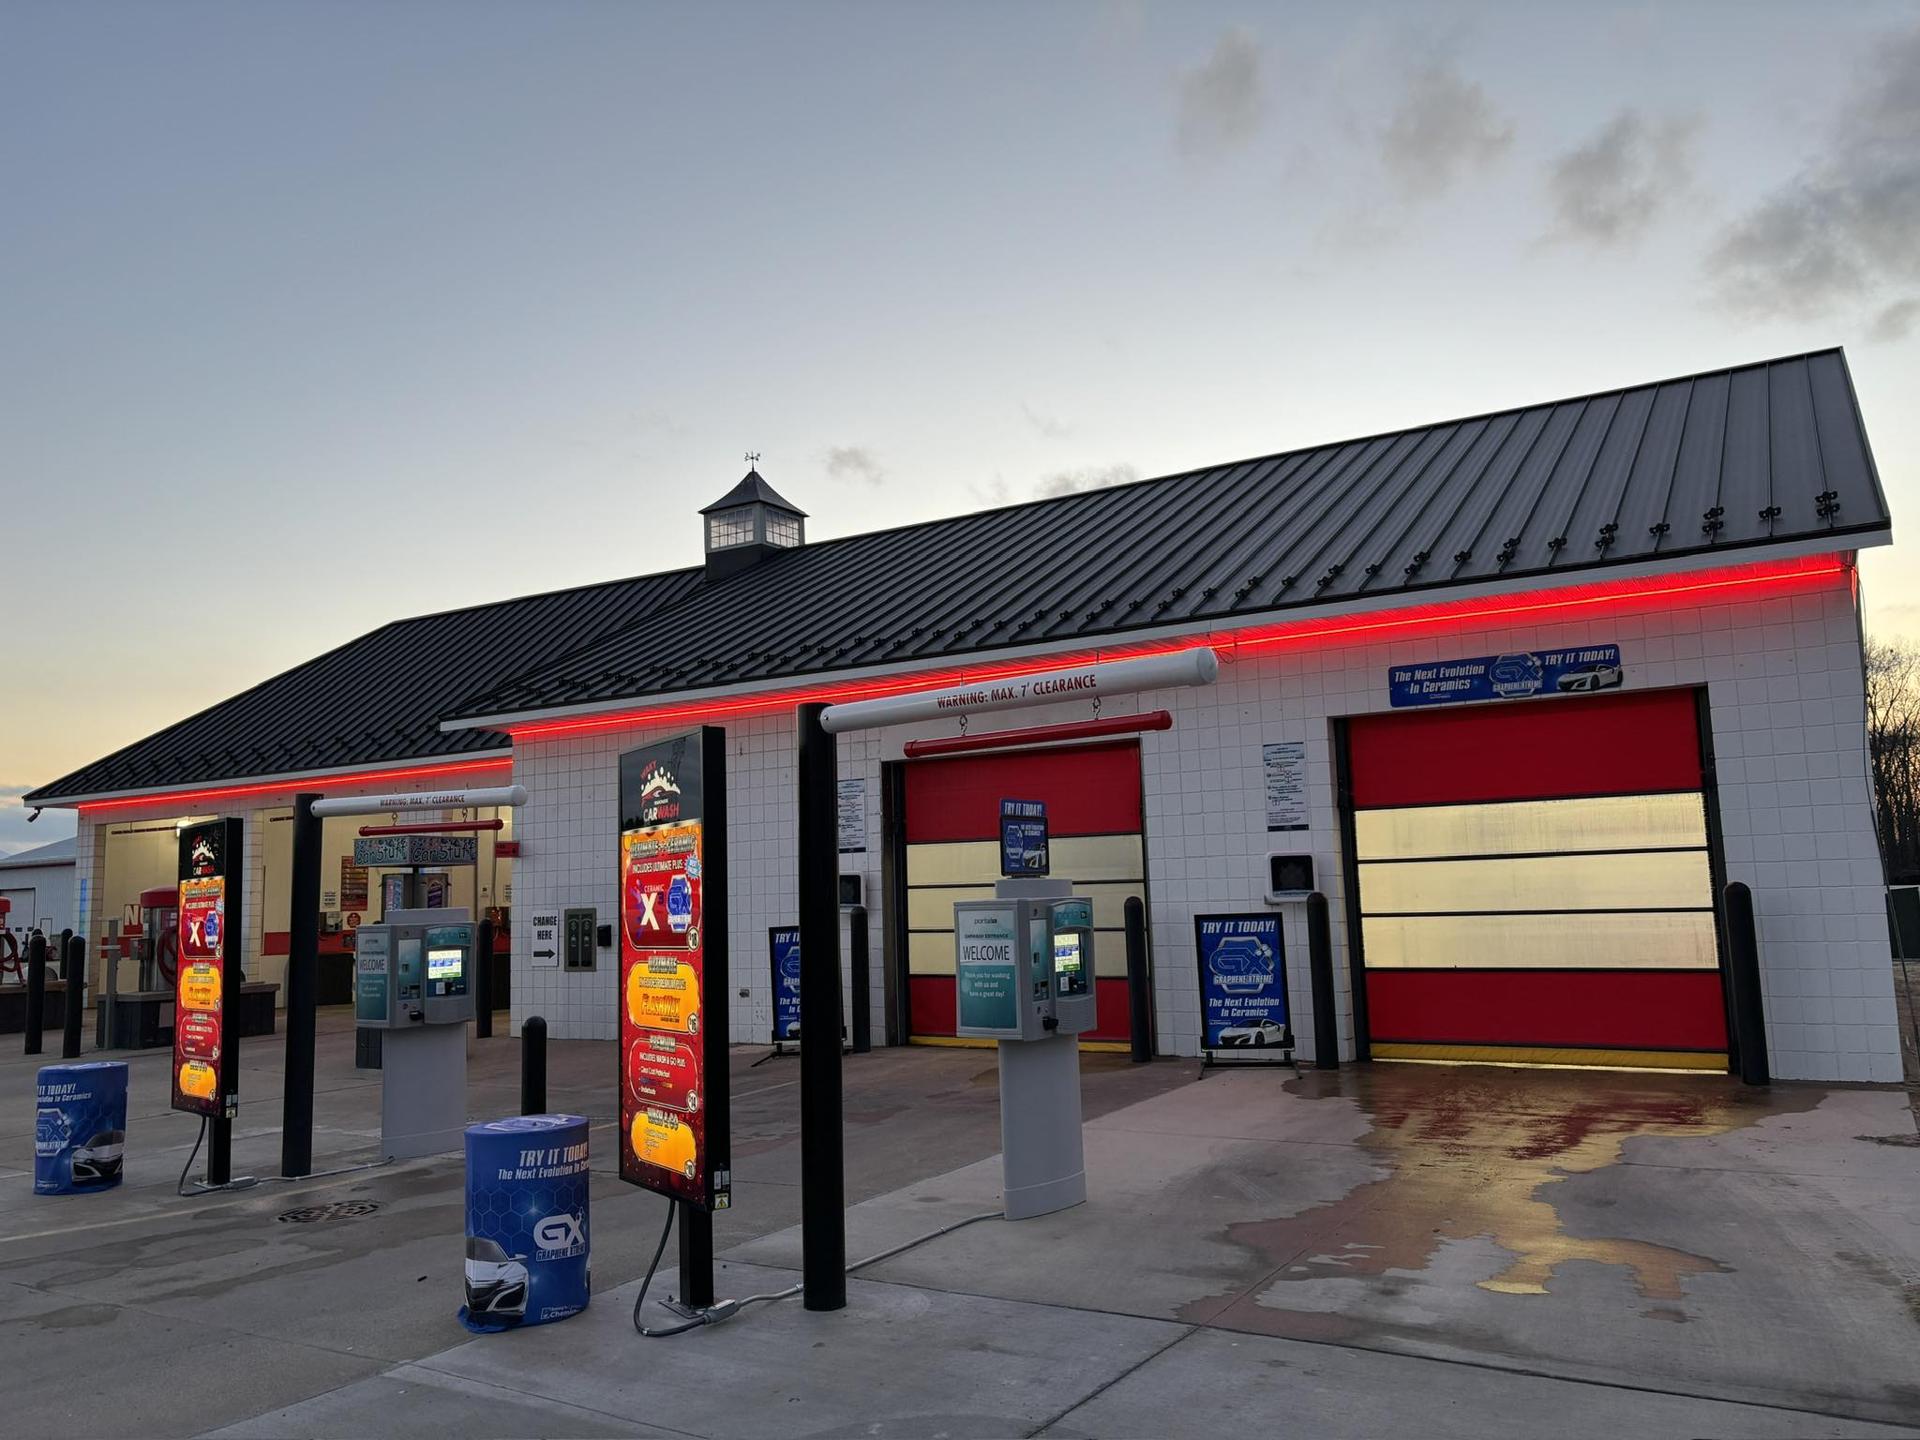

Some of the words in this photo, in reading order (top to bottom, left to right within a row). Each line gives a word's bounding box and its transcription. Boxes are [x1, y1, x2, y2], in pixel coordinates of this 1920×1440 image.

[1545, 653, 1563, 665] TRY
[1566, 652, 1577, 664] IT
[1579, 649, 1615, 662] TODAY!
[1395, 671, 1411, 682] The
[1414, 668, 1437, 680] Next
[1440, 665, 1485, 678] Evolution
[937, 691, 988, 709] WARNING:
[991, 687, 1018, 702] MAX.
[1021, 682, 1030, 697] 7'
[1033, 674, 1097, 695] CLEARANCE
[1409, 682, 1419, 694] In
[1422, 679, 1470, 693] Ceramics
[432, 794, 465, 804] CLEARANCE
[1004, 802, 1015, 815] TRY
[1015, 802, 1021, 816] IT
[1022, 803, 1043, 816] TODAY!
[438, 844, 474, 862] Stuff
[533, 916, 557, 926] CHANGE
[1203, 922, 1222, 933] TRY
[1224, 921, 1234, 933] IT
[1238, 920, 1276, 933] TODAY!
[537, 930, 552, 940] HERE
[775, 933, 791, 943] TRY
[963, 945, 1010, 960] WELCOME
[360, 959, 385, 971] WELCOME
[780, 997, 790, 1005] The
[1209, 998, 1222, 1007] The
[1224, 998, 1242, 1007] Next
[1244, 997, 1280, 1007] Evolution
[1221, 1008, 1229, 1017] In
[1231, 1007, 1269, 1017] Ceramics
[47, 1083, 76, 1095] TODAY!
[62, 1092, 92, 1101] Ceramics
[520, 1150, 544, 1167] TRY
[548, 1148, 560, 1165] IT
[498, 1169, 512, 1180] The
[515, 1168, 536, 1180] Next
[539, 1165, 573, 1178] Evolution
[533, 1213, 586, 1250] GX
